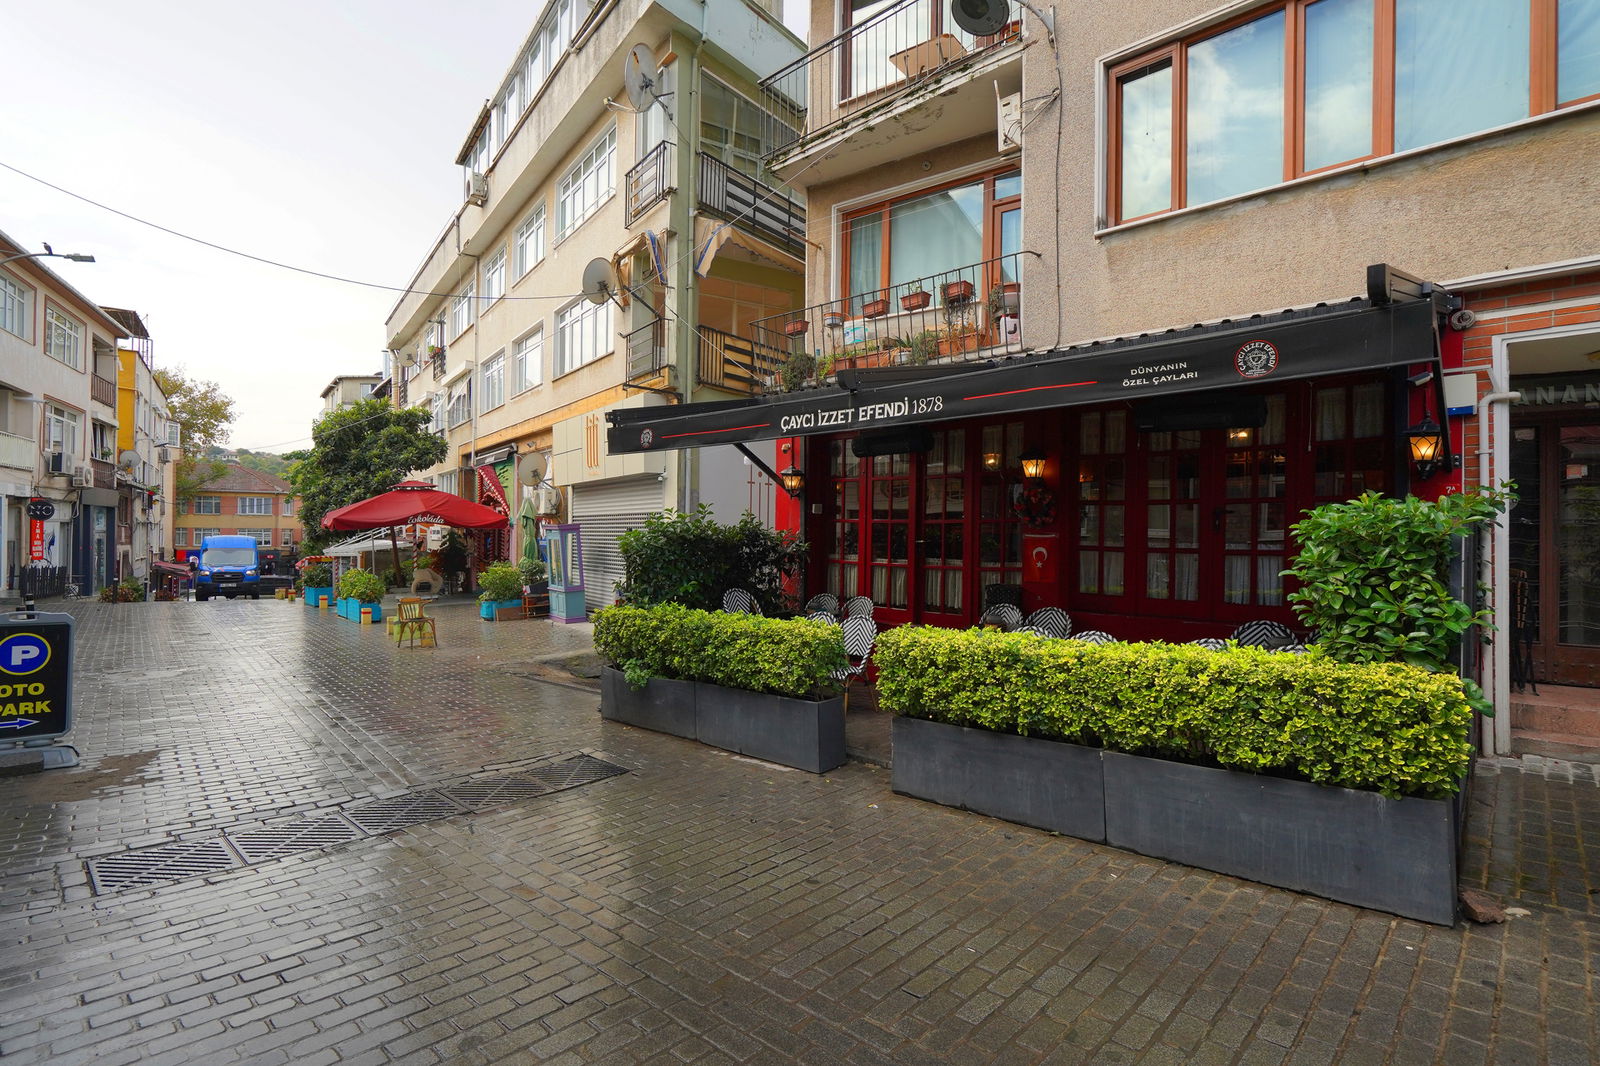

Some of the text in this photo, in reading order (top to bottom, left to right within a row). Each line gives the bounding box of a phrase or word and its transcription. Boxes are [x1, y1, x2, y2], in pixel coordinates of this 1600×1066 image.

[1130, 361, 1187, 376] DÜNYANIN
[1122, 371, 1198, 387] ÖZEL ÇAYLARI
[780, 395, 943, 432] ÇAYCI İZZET EFENDİ 1878
[11, 645, 40, 666] P
[0, 682, 45, 698] OTO
[0, 700, 52, 717] ARK
